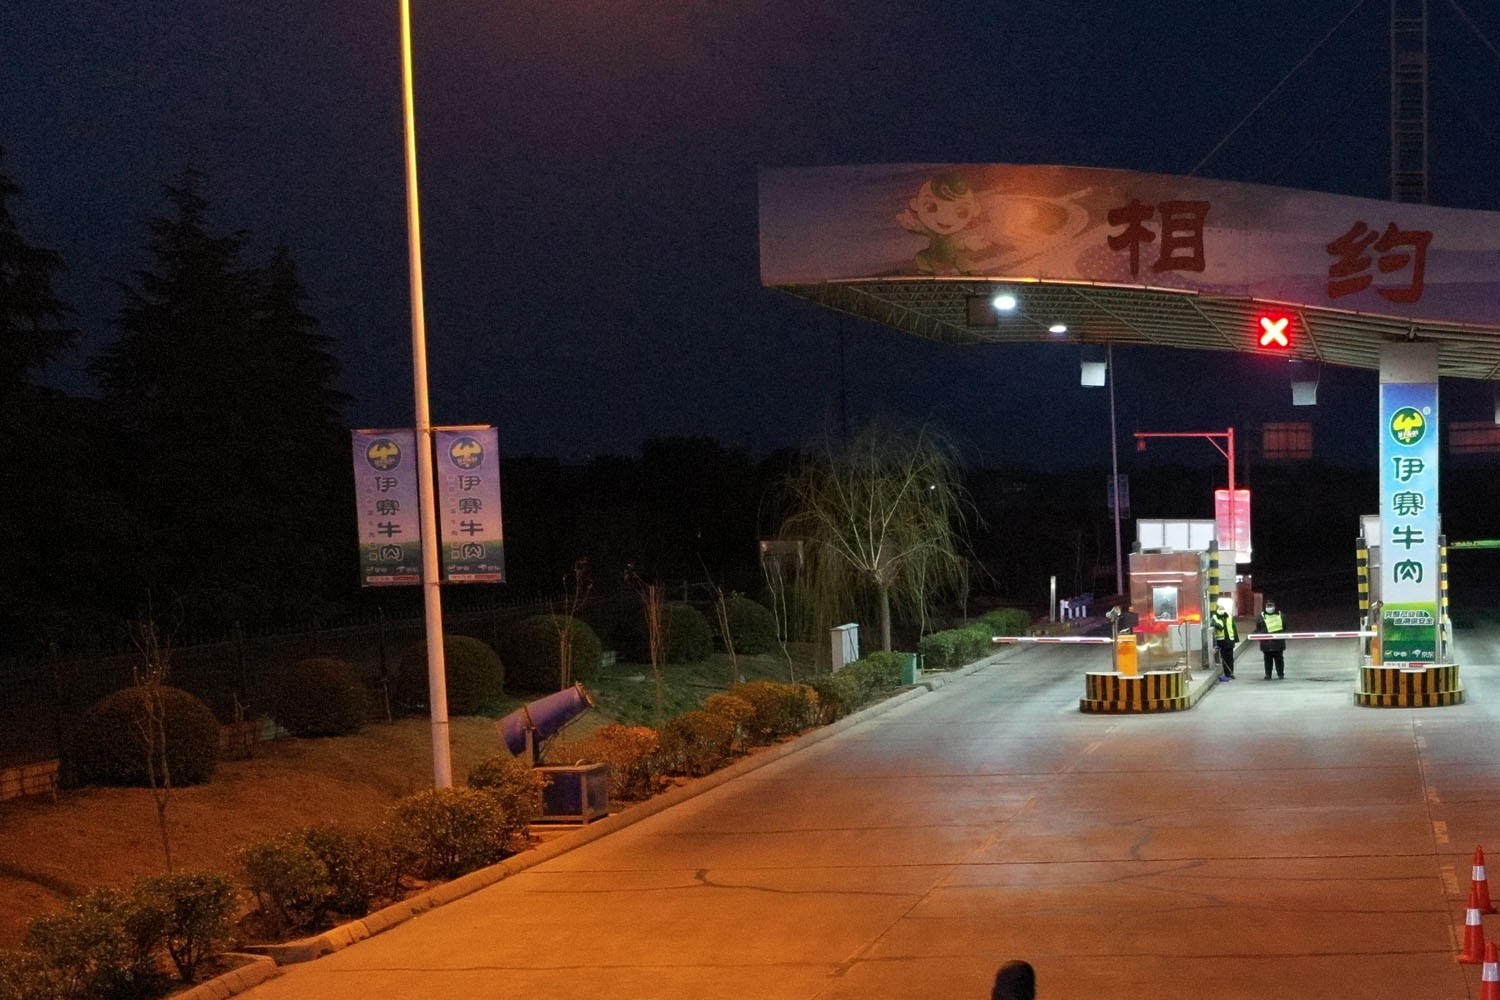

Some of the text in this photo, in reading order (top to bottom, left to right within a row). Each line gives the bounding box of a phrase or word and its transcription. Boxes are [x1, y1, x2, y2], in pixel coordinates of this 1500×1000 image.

[374, 475, 404, 561] 伊赛牛肉
[458, 474, 485, 560] 伊赛牛肉
[1391, 456, 1426, 584] 伊赛牛肉
